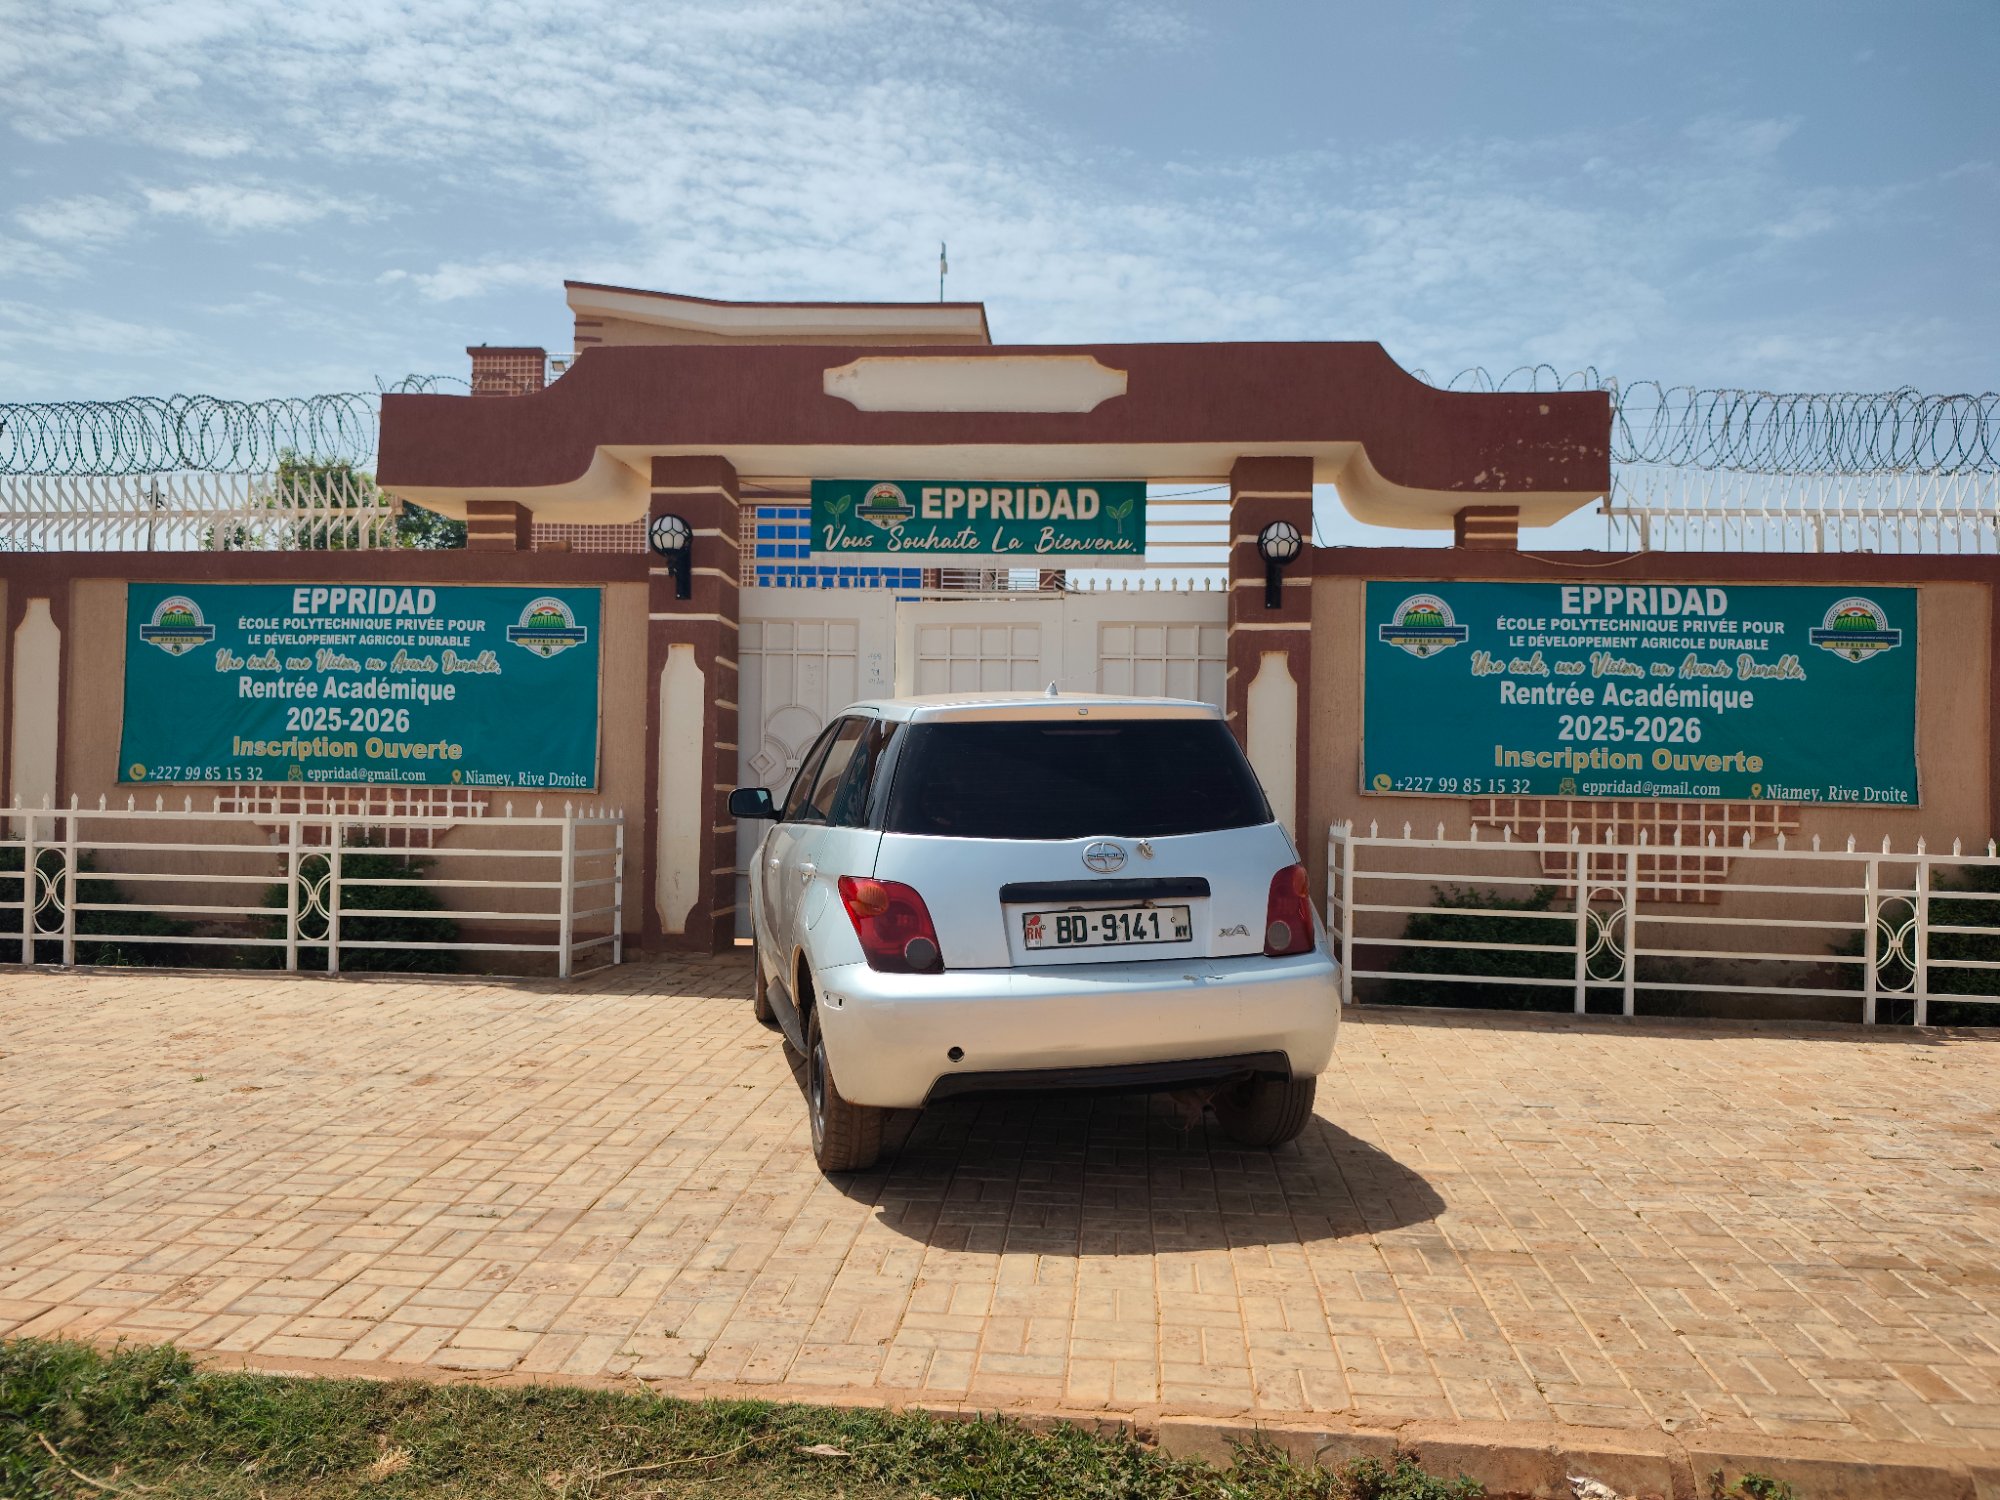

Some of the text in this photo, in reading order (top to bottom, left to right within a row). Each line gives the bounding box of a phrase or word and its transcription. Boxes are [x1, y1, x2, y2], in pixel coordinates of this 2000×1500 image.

[922, 488, 1099, 519] EPPRIDAD
[822, 524, 1137, 553] Vous Souhaite La Bienvenu.
[293, 588, 436, 614] EPPRIDAD
[1561, 587, 1727, 616] EPPRIDAD
[239, 616, 485, 631] ÉCOLE POLYTECHNIQUE PRIVÉE POUR
[1497, 615, 1784, 634] ÉCOLE POLYTECHNIQUE PRIVÉE POUR
[248, 632, 470, 646] LE DÉVELOPPEMENT AGRICOLE DURABLE
[1510, 634, 1768, 650] LE DÉVELOPPEMENT AGRICOLE DURABLE
[215, 648, 244, 672] Une
[246, 648, 282, 672] école,
[285, 654, 312, 672] une
[314, 650, 361, 673] Vision,
[389, 650, 438, 674] Avenir
[1471, 650, 1507, 677] Une
[1508, 651, 1551, 677] école,
[1555, 657, 1587, 676] une
[1589, 652, 1645, 678] Vision,
[1678, 652, 1732, 680] Avenir
[239, 676, 455, 705] Rentrée Académique
[1501, 681, 1753, 714] Rentrée Académique
[286, 707, 409, 732] 2025-2026
[1558, 715, 1701, 743] 2025-2026
[233, 736, 462, 761] Inscription Ouverte
[1495, 745, 1763, 774] Inscription Ouverte
[148, 766, 263, 781] +227 99 85 15 32
[307, 766, 426, 782] eppridad@gmail.com
[465, 770, 587, 787] Niamey, Rive Droite
[1394, 776, 1531, 794] +227 99 85 15 32
[1582, 780, 1722, 797] eppridad@gmail.com
[1766, 784, 1909, 802] Niamey, Rive Droite
[1027, 928, 1042, 939] RN
[1056, 912, 1160, 943] BD-9141
